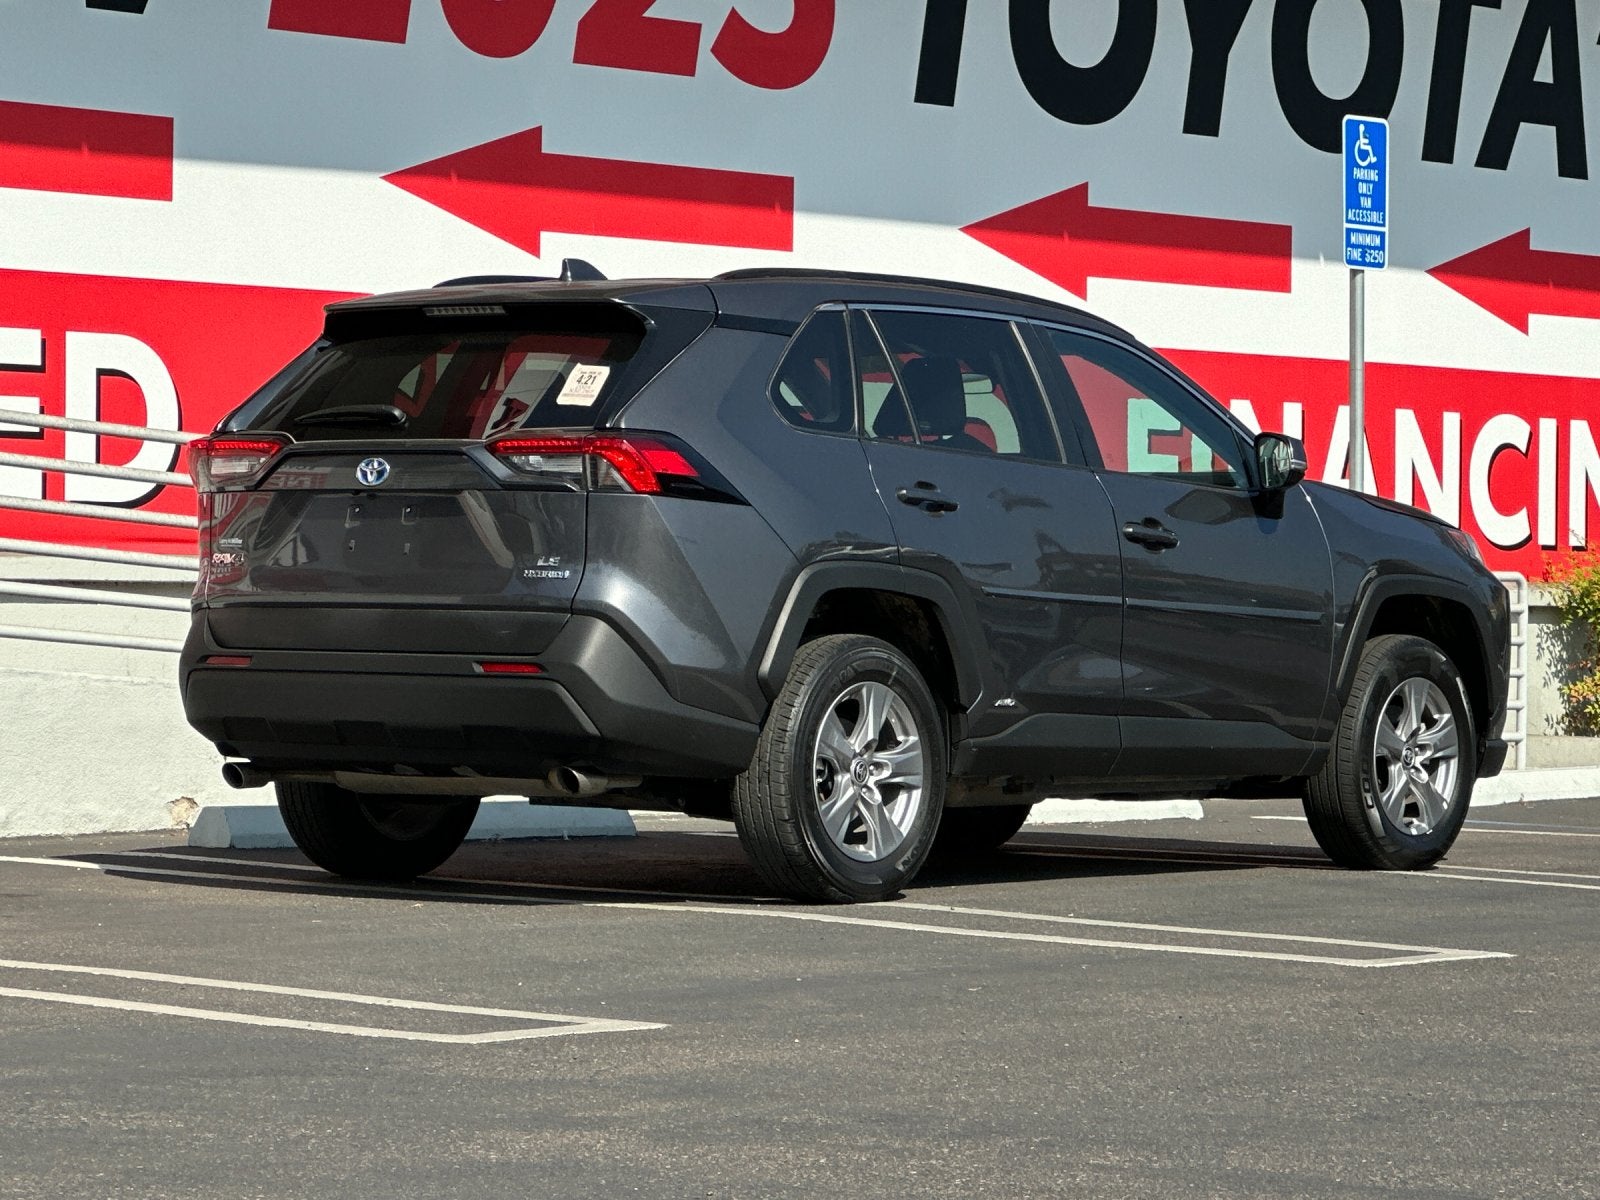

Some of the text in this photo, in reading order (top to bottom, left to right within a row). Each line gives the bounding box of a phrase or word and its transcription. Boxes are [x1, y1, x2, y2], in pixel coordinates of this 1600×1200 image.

[1353, 167, 1379, 182] PARKING
[1358, 182, 1373, 195] ONLY
[1360, 197, 1372, 208] VAN
[1347, 209, 1383, 223] ACCESSIBLE
[1350, 231, 1381, 247] MINIMUM
[1347, 247, 1384, 264] FINE $250
